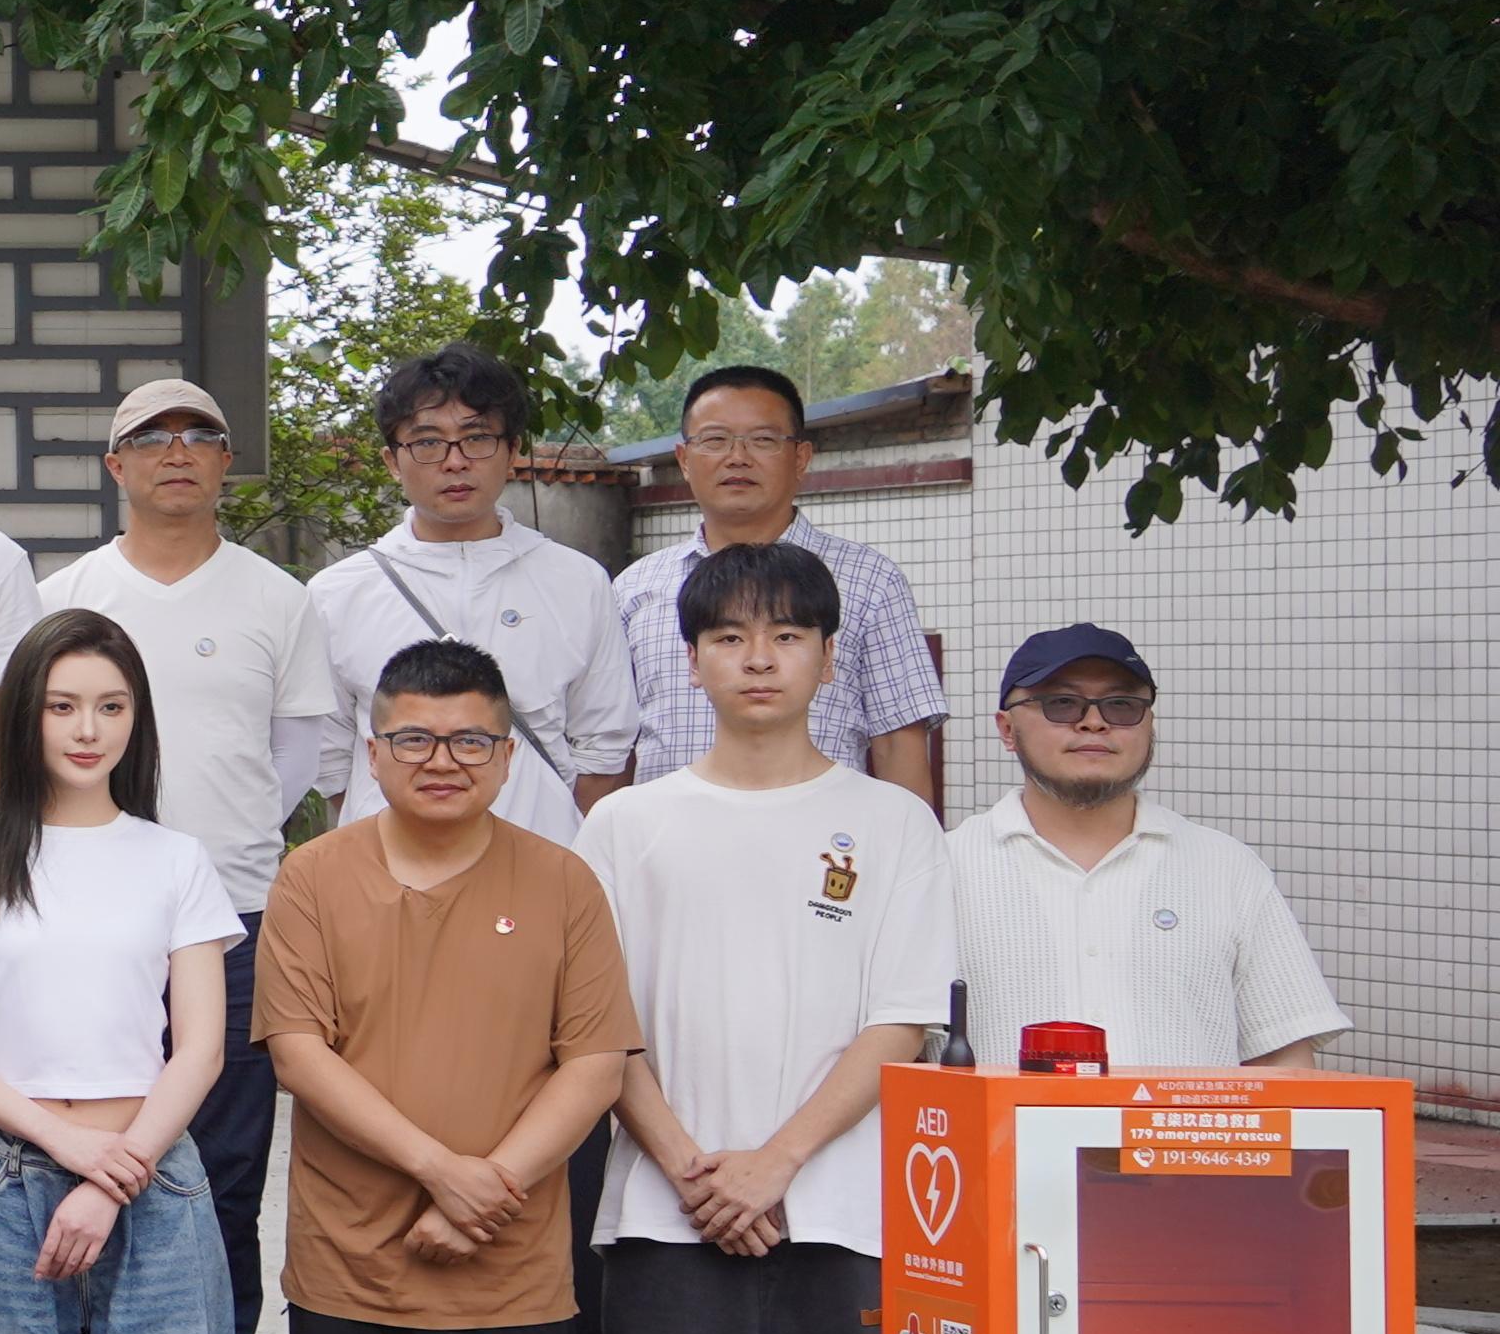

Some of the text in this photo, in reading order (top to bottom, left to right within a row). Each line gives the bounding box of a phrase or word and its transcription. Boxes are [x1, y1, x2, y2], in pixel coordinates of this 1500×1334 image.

[916, 1107, 948, 1138] AED
[1130, 1129, 1281, 1143] 179 emergency rescue
[1162, 1150, 1271, 1166] 191-9646-4349
